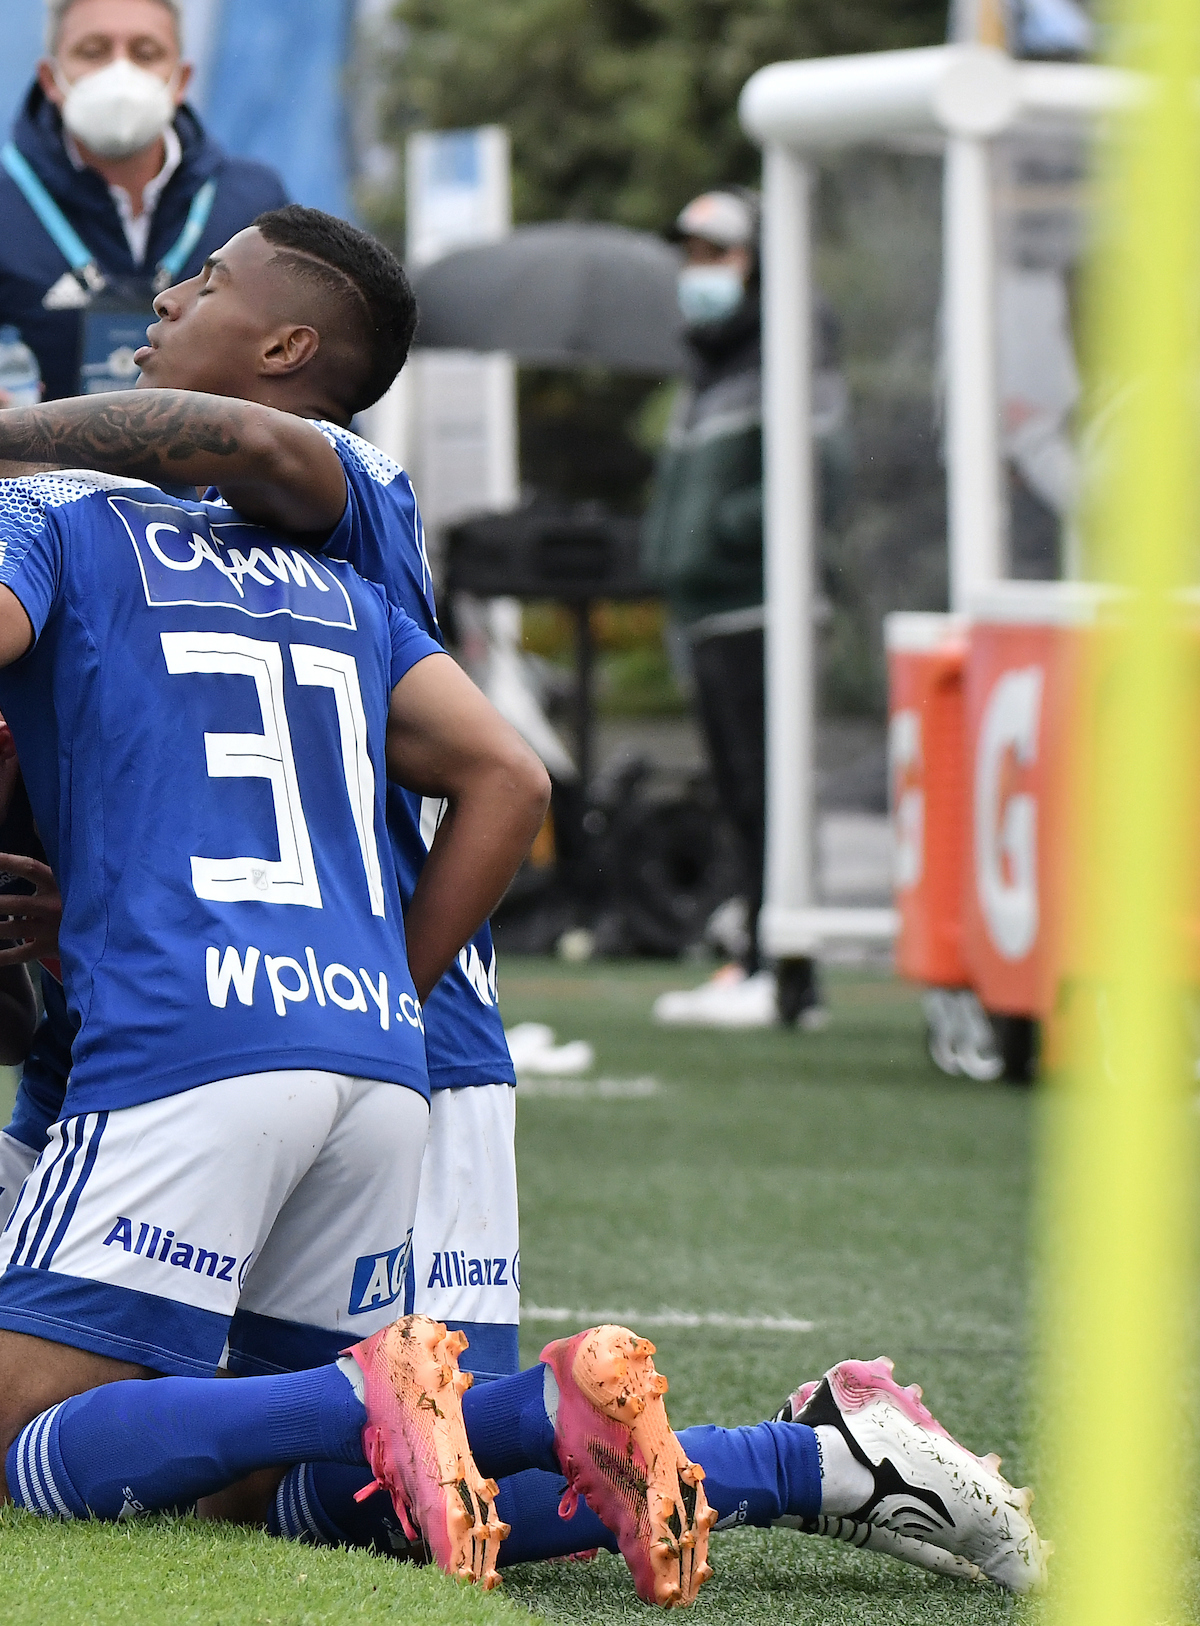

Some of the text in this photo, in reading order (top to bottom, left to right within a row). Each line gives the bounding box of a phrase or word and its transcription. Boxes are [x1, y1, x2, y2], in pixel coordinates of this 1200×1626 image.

[160, 631, 386, 920] 31
[974, 663, 1044, 963] G
[102, 1216, 237, 1283] Allianz
[427, 1250, 509, 1289] Allianz
